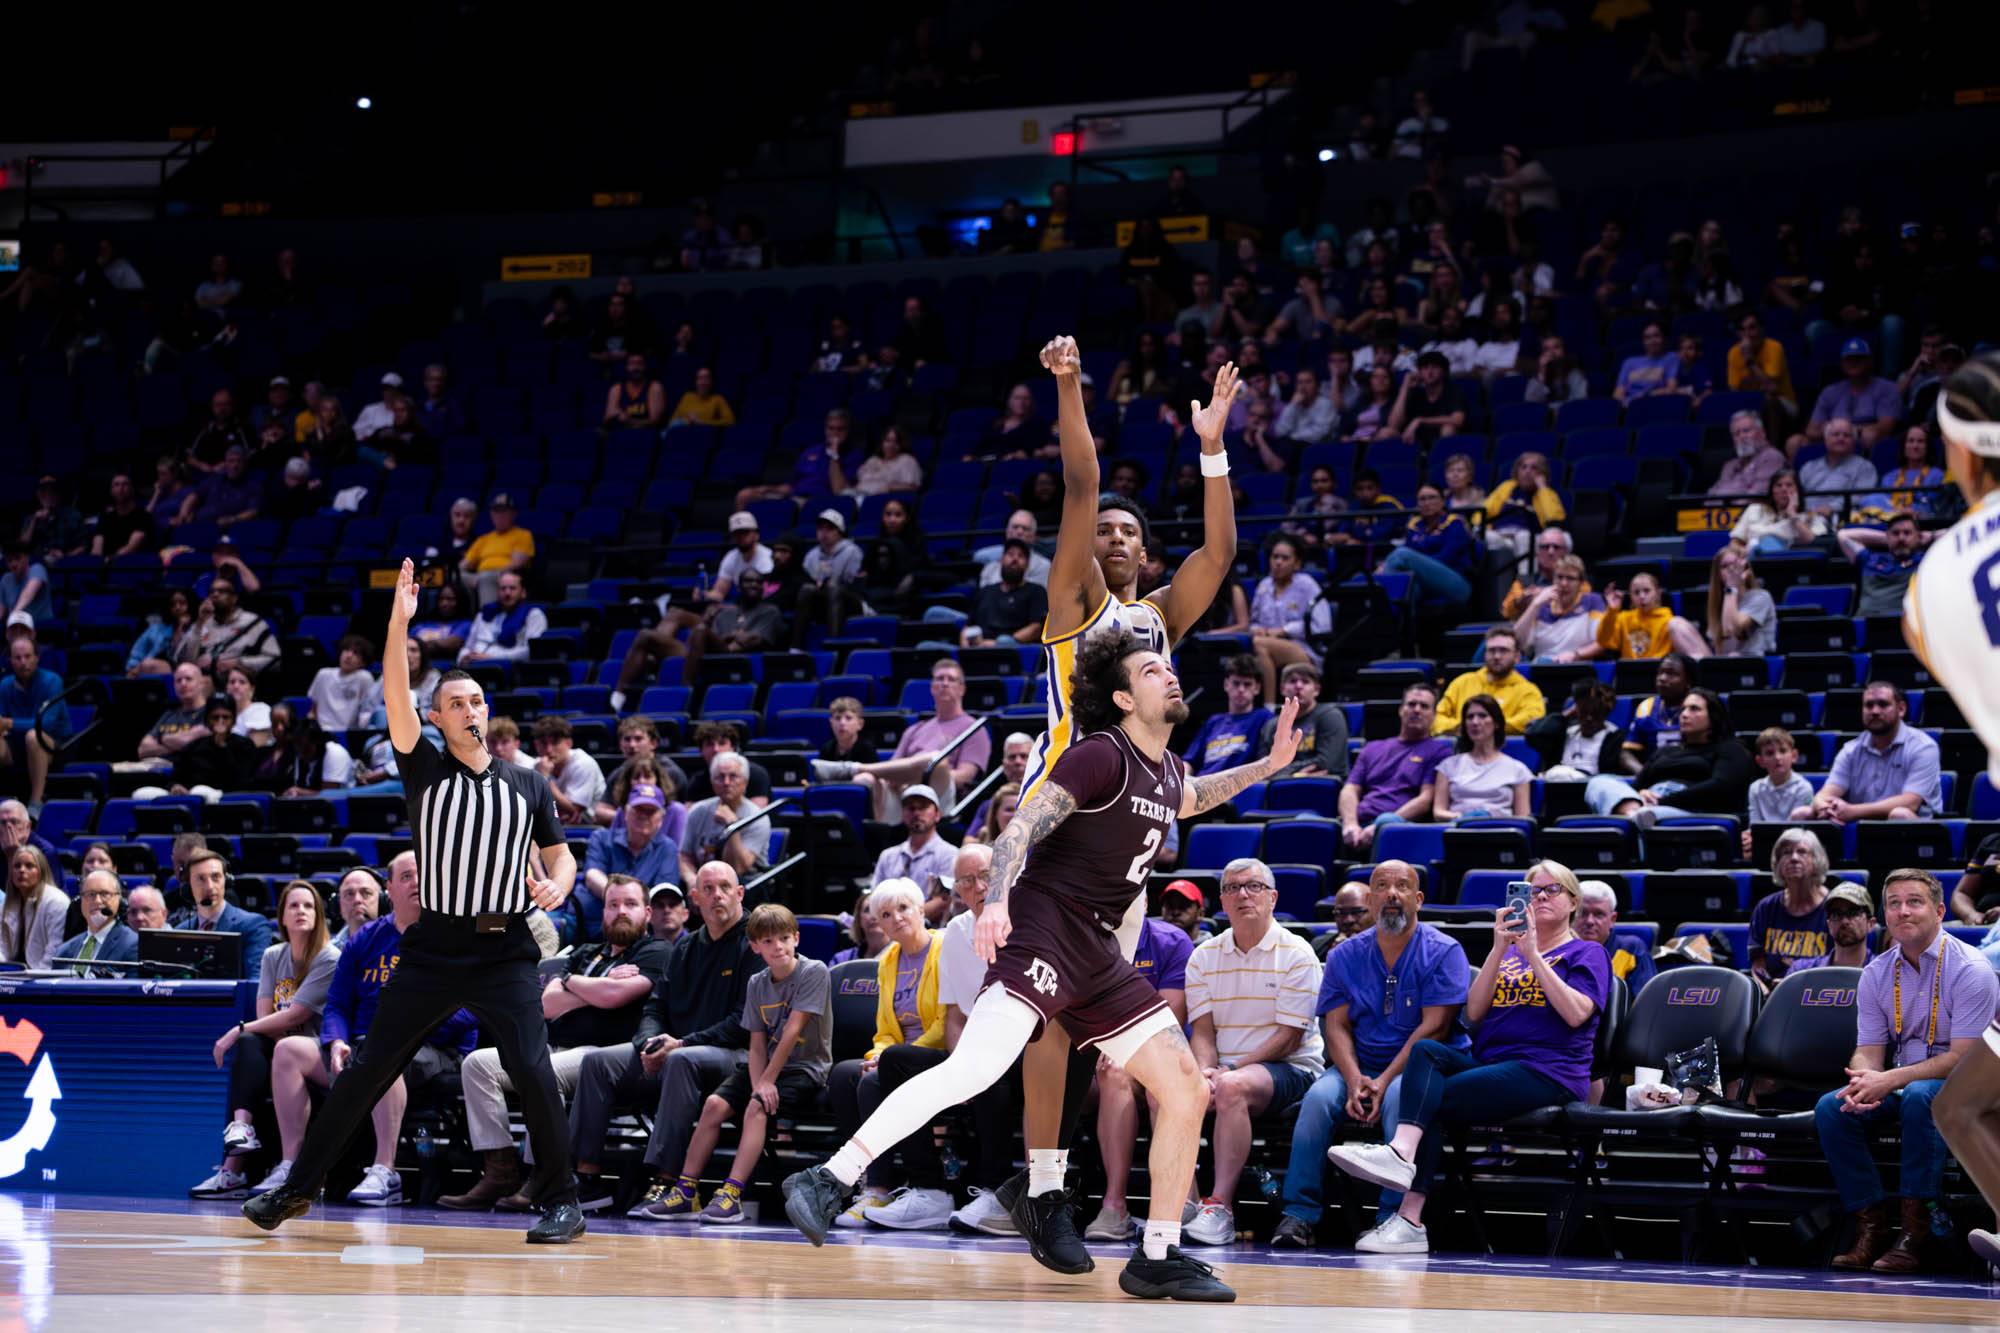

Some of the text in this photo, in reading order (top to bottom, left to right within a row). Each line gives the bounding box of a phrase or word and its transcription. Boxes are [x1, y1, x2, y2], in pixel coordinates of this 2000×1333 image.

[1131, 795, 1165, 823] TEXAS
[1125, 827, 1162, 885] 2
[1763, 927, 1829, 957] TIGERS
[379, 954, 400, 969] LS
[1134, 960, 1154, 968] LSU
[362, 968, 391, 984] TIG
[1667, 987, 1721, 1006] LSU
[1801, 988, 1855, 1007] LSU
[1646, 1091, 1670, 1104] LS
[42, 1168, 57, 1181] TM
